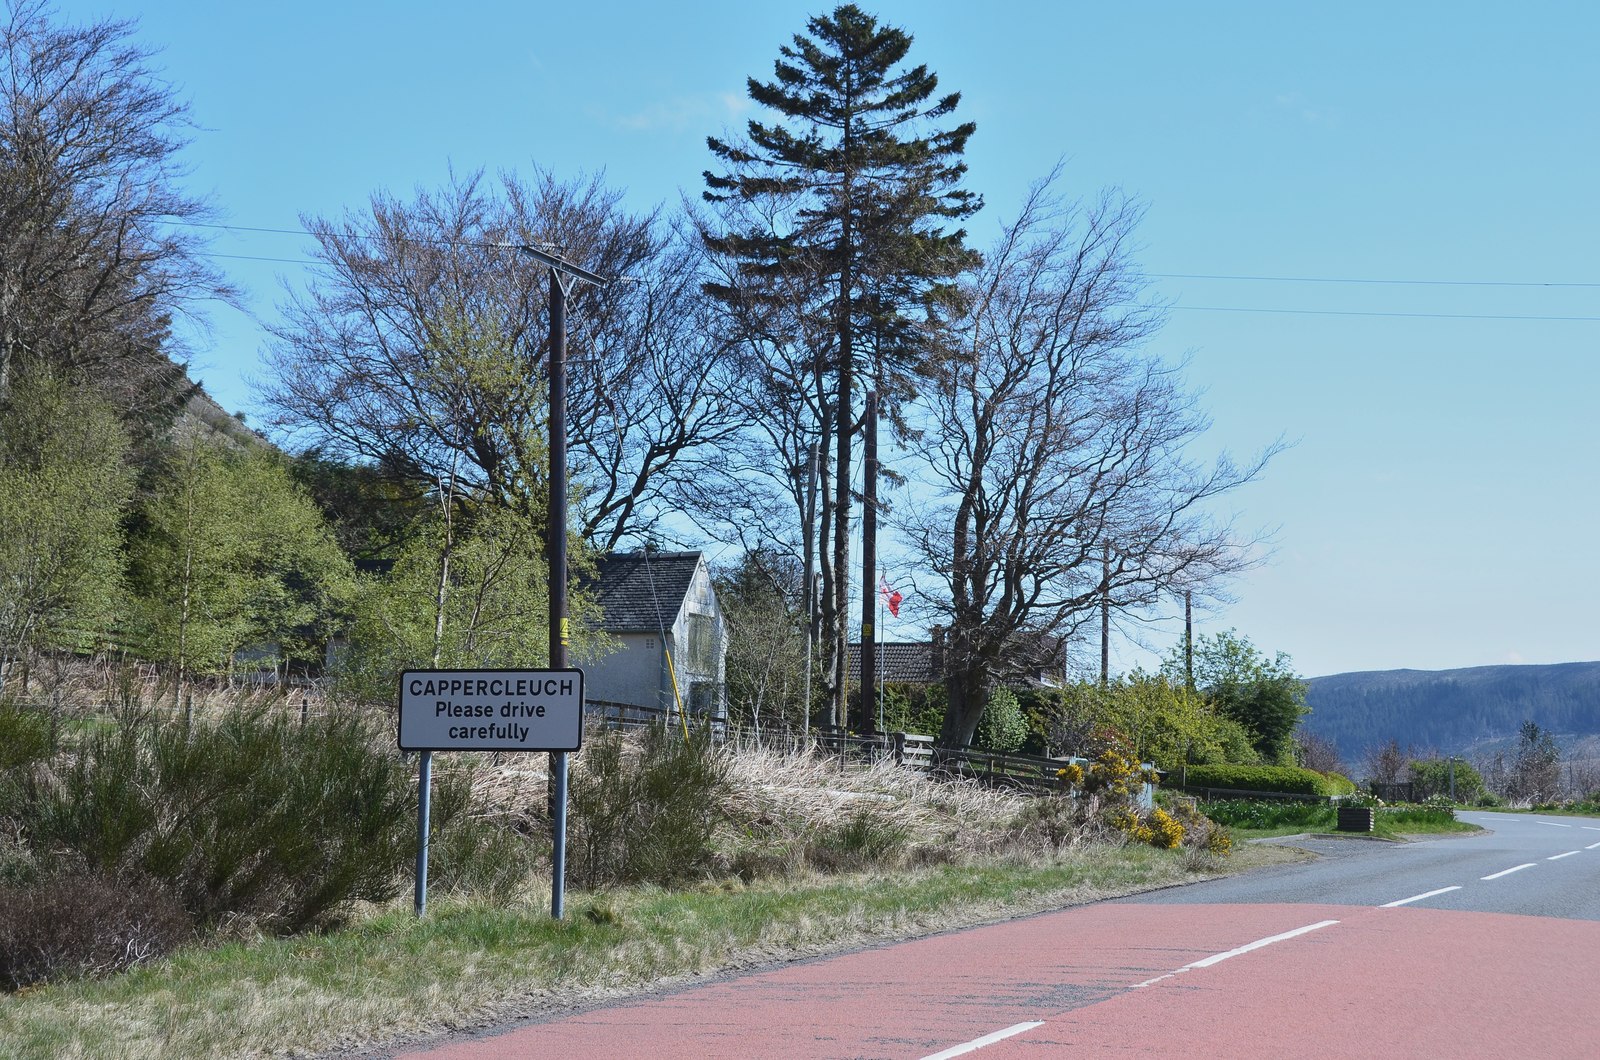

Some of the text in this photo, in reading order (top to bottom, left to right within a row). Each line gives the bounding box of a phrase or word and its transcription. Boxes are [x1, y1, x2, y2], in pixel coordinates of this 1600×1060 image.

[410, 680, 573, 696] CAPPERCLEUCH
[436, 702, 546, 717] Please drive
[449, 723, 529, 742] carefully
